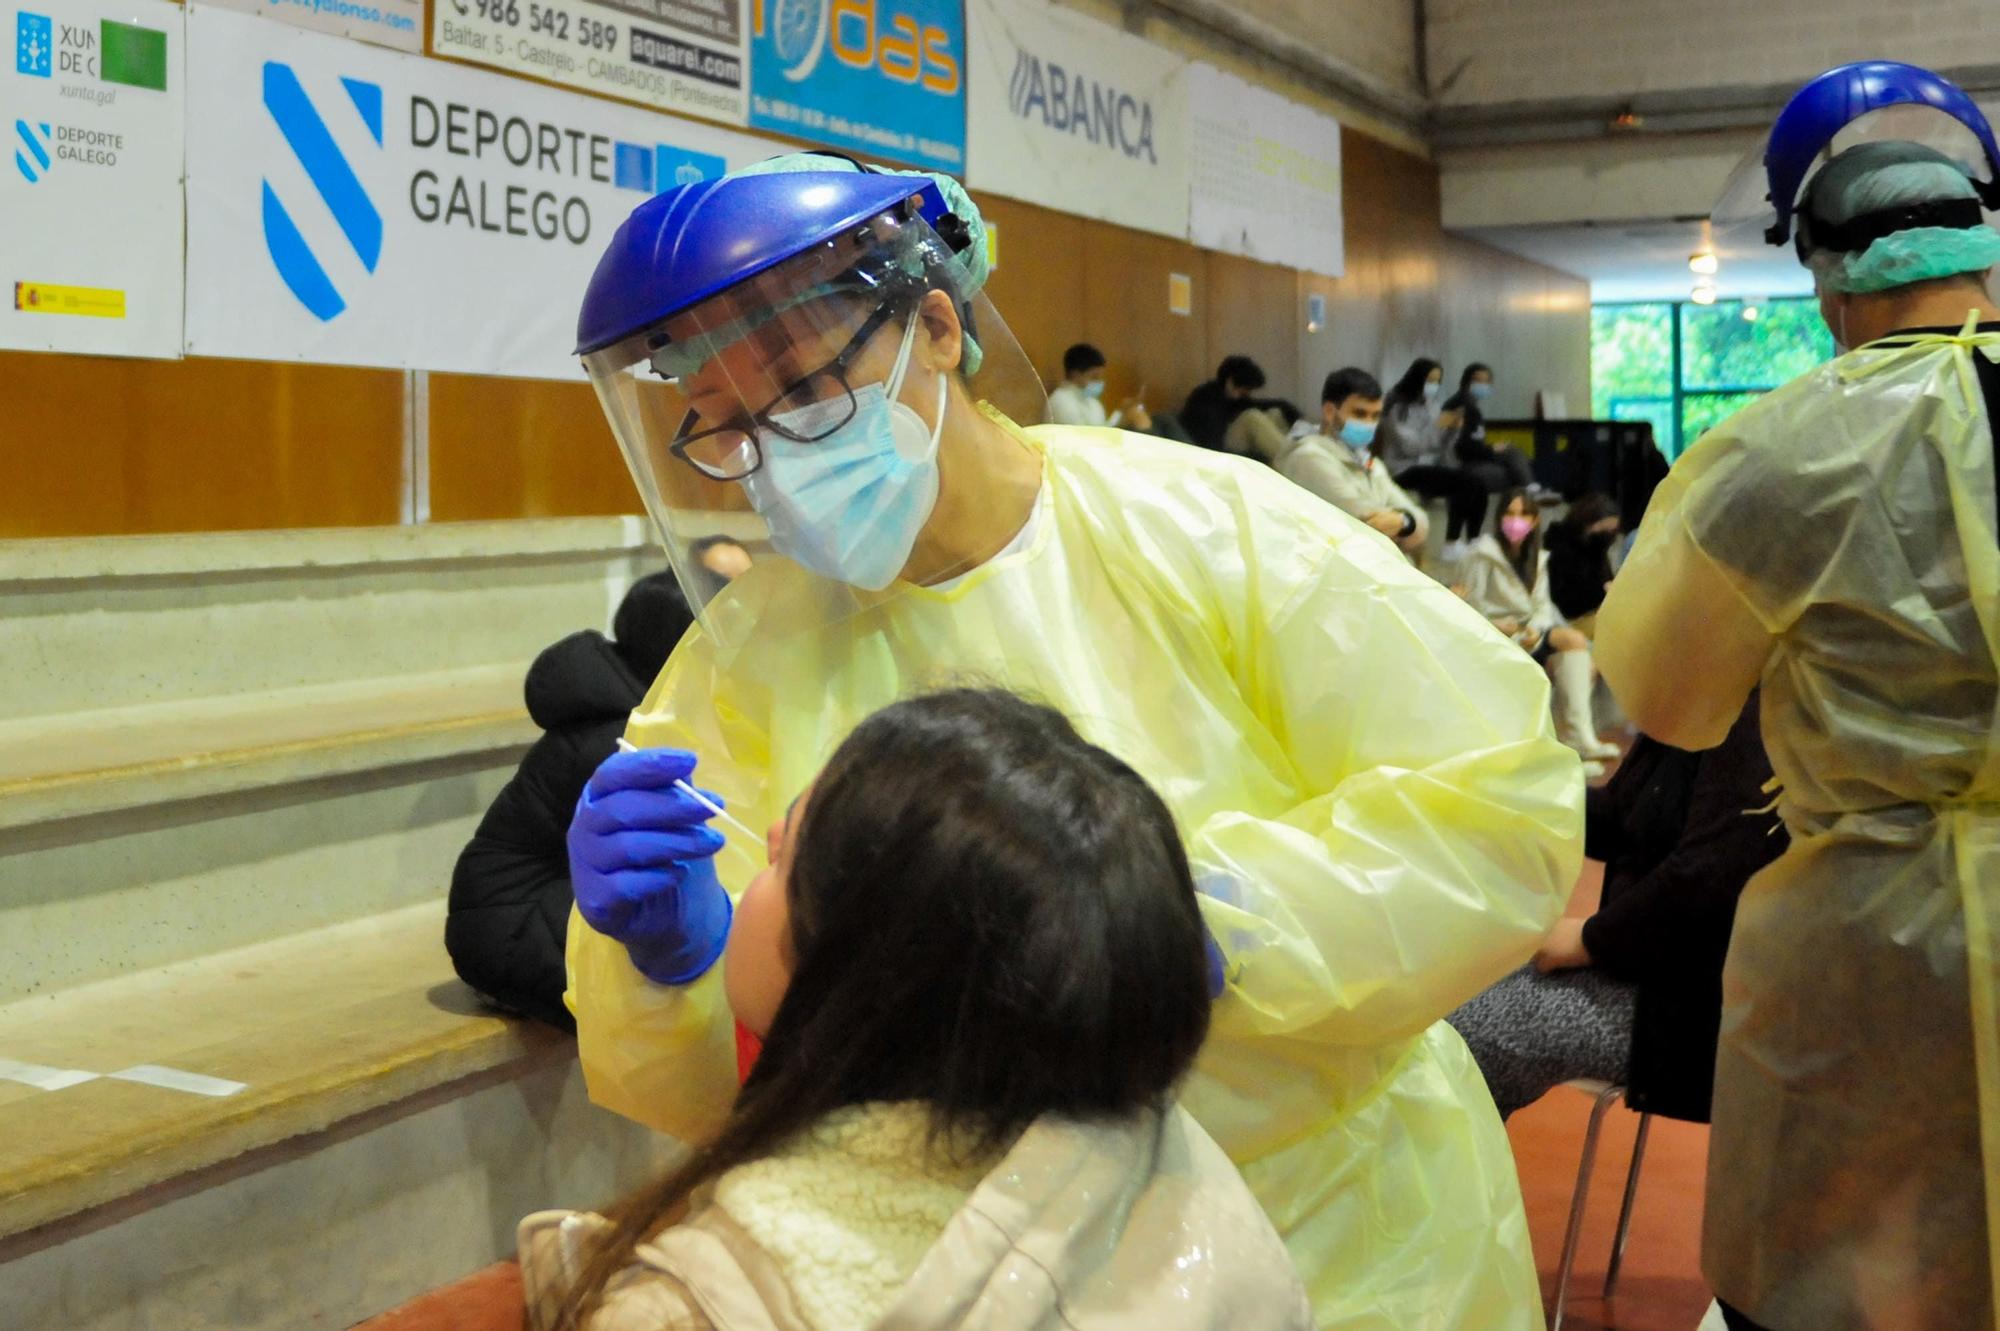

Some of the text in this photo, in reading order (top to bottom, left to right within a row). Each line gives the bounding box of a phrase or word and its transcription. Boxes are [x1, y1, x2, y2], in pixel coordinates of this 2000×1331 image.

[475, 0, 520, 27] 986
[530, 3, 569, 41] 542
[578, 17, 617, 52] 589
[59, 51, 82, 74] DE
[495, 34, 504, 54] 5
[587, 57, 665, 95] CAMBADOS
[632, 34, 740, 82] aquarel.com
[59, 83, 116, 106] xunta.gal
[1022, 55, 1158, 165] ABANCA
[57, 126, 123, 150] DEPORTE
[57, 145, 117, 167] GALEGO
[410, 95, 610, 183] DEPORTE
[409, 169, 591, 246] GALEGO
